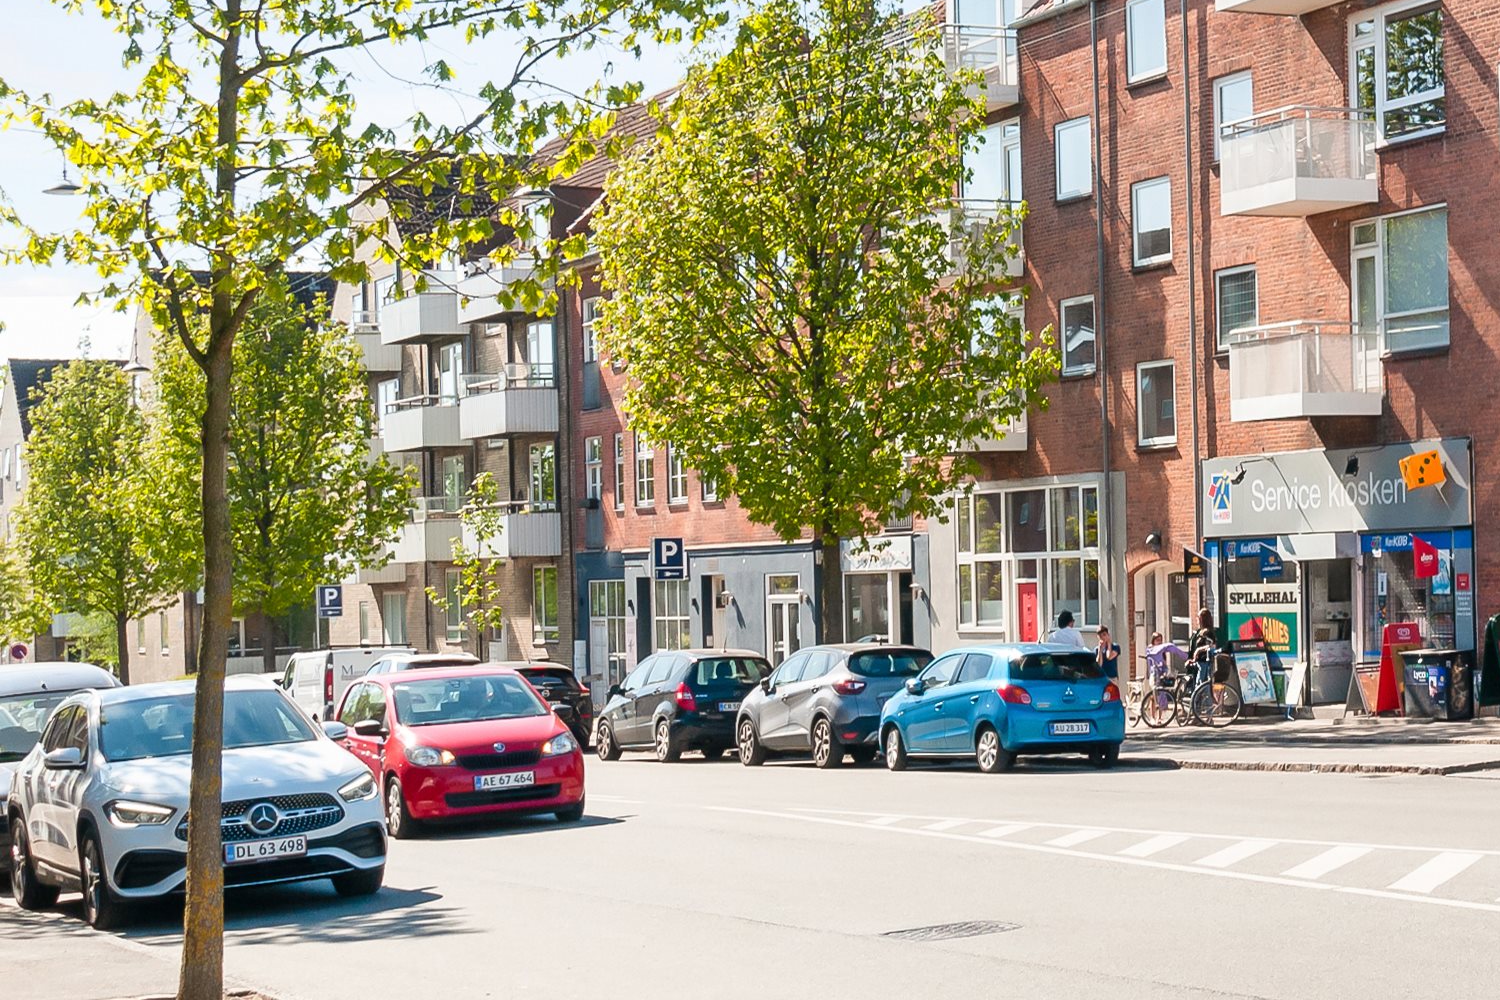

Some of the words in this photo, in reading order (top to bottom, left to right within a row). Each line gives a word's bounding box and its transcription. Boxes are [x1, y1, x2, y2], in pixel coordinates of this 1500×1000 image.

[1251, 477, 1321, 512] Service
[1328, 471, 1406, 507] kiosken
[661, 541, 678, 565] P
[324, 588, 338, 606] P
[1229, 591, 1297, 605] SPILLEHAL
[1262, 616, 1290, 644] GAMES
[1055, 724, 1065, 732] AU
[1076, 724, 1088, 732] 317
[483, 776, 496, 786] AE
[498, 775, 511, 785] 67
[513, 773, 533, 784] 464
[236, 845, 255, 858] DL
[259, 842, 275, 856] 63
[279, 839, 304, 853] 498
